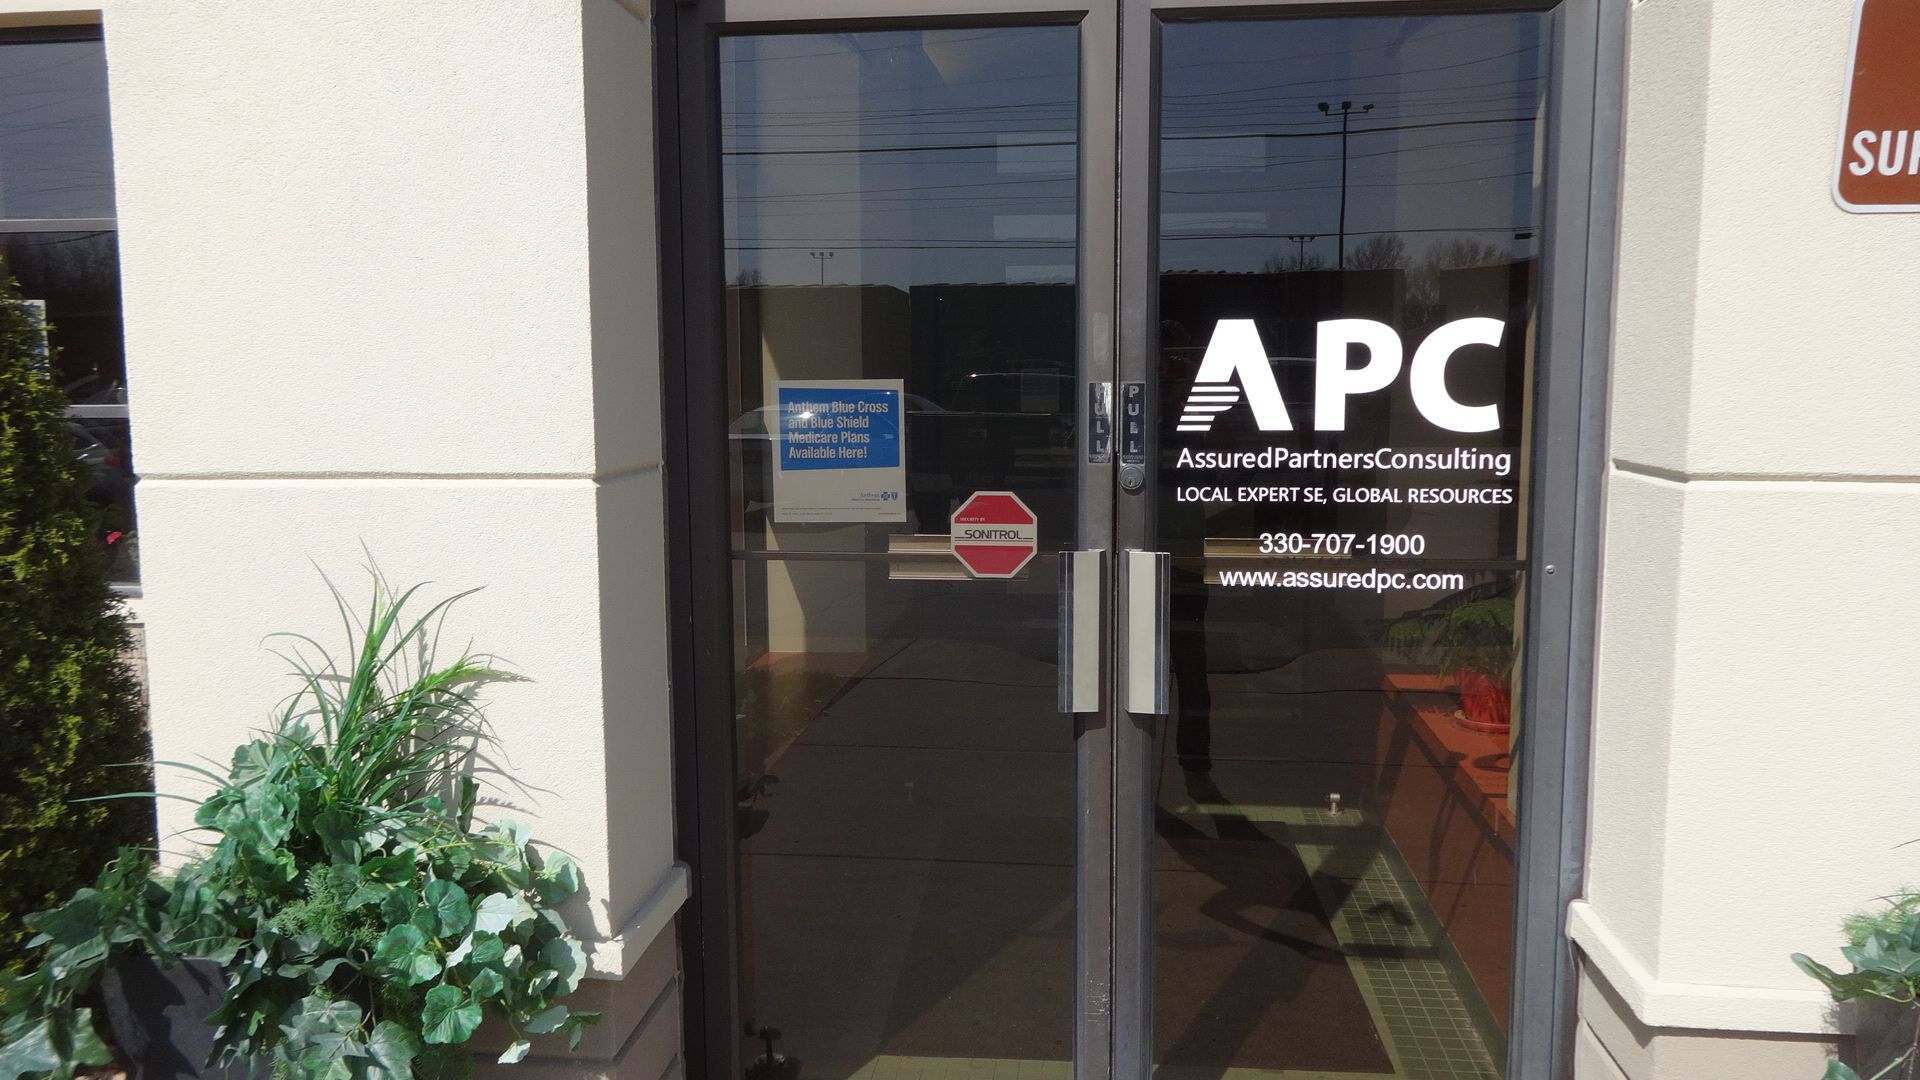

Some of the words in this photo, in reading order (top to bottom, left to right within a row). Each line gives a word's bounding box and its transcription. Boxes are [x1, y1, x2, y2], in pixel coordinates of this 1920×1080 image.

[1176, 317, 1506, 433] APC
[787, 401, 829, 413] Anthem
[831, 401, 855, 413] Blue
[857, 401, 889, 413] Cross
[788, 416, 808, 429] and
[810, 416, 834, 429] Blue
[836, 416, 869, 429] Shield
[788, 431, 838, 444] Medicare
[841, 431, 870, 444] Plans
[788, 446, 836, 459] Available
[838, 446, 867, 459] Here!
[1176, 447, 1512, 476] AssuredPartnersConsulting
[1176, 487, 1233, 503] LOCAL
[1332, 488, 1403, 504] GLOBAL
[1408, 488, 1513, 505] RESOURCES
[964, 529, 1023, 540] SONITROL
[1258, 533, 1425, 556] 330-707-1900
[1219, 568, 1464, 593] www.assuredpc.com
